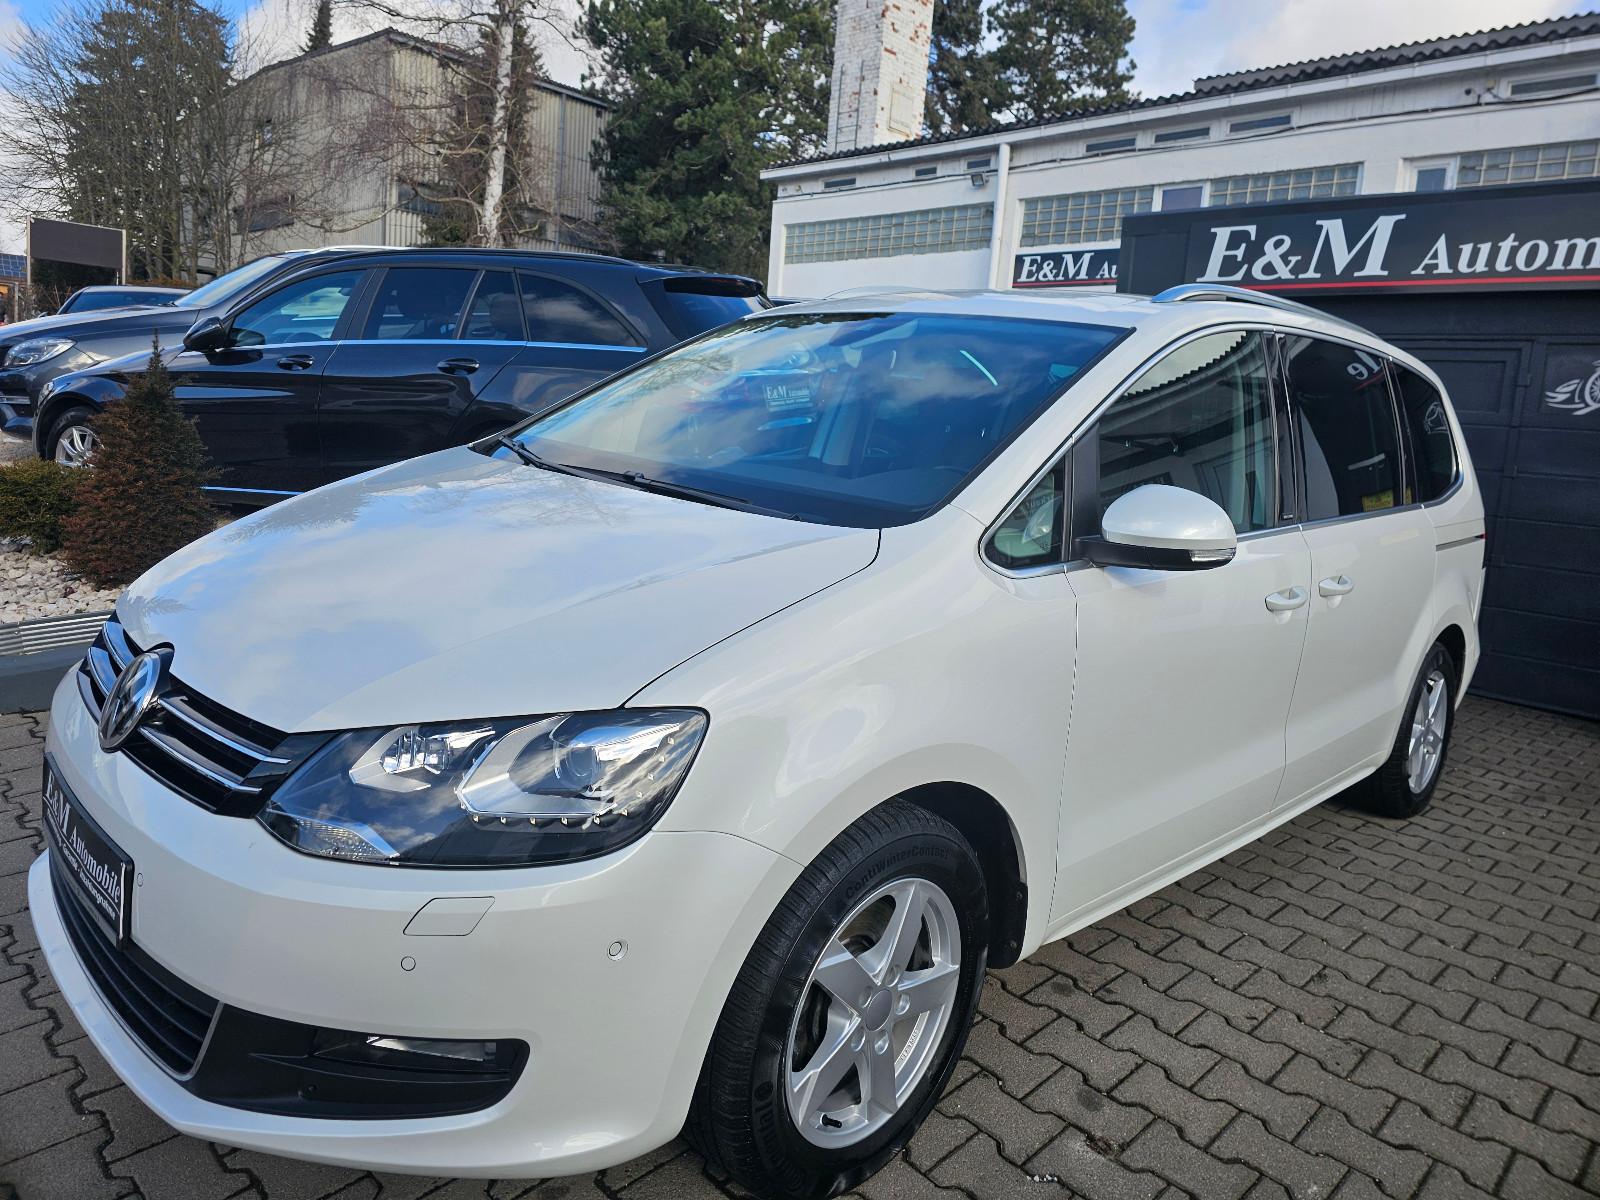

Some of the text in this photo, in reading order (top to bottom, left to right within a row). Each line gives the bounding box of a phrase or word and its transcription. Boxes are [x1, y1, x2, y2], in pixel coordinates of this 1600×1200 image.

[1017, 252, 1095, 282] E&M
[1196, 214, 1406, 283] E&M
[45, 769, 121, 903] E&M Automobile
[845, 845, 952, 900] ContiWinterContact
